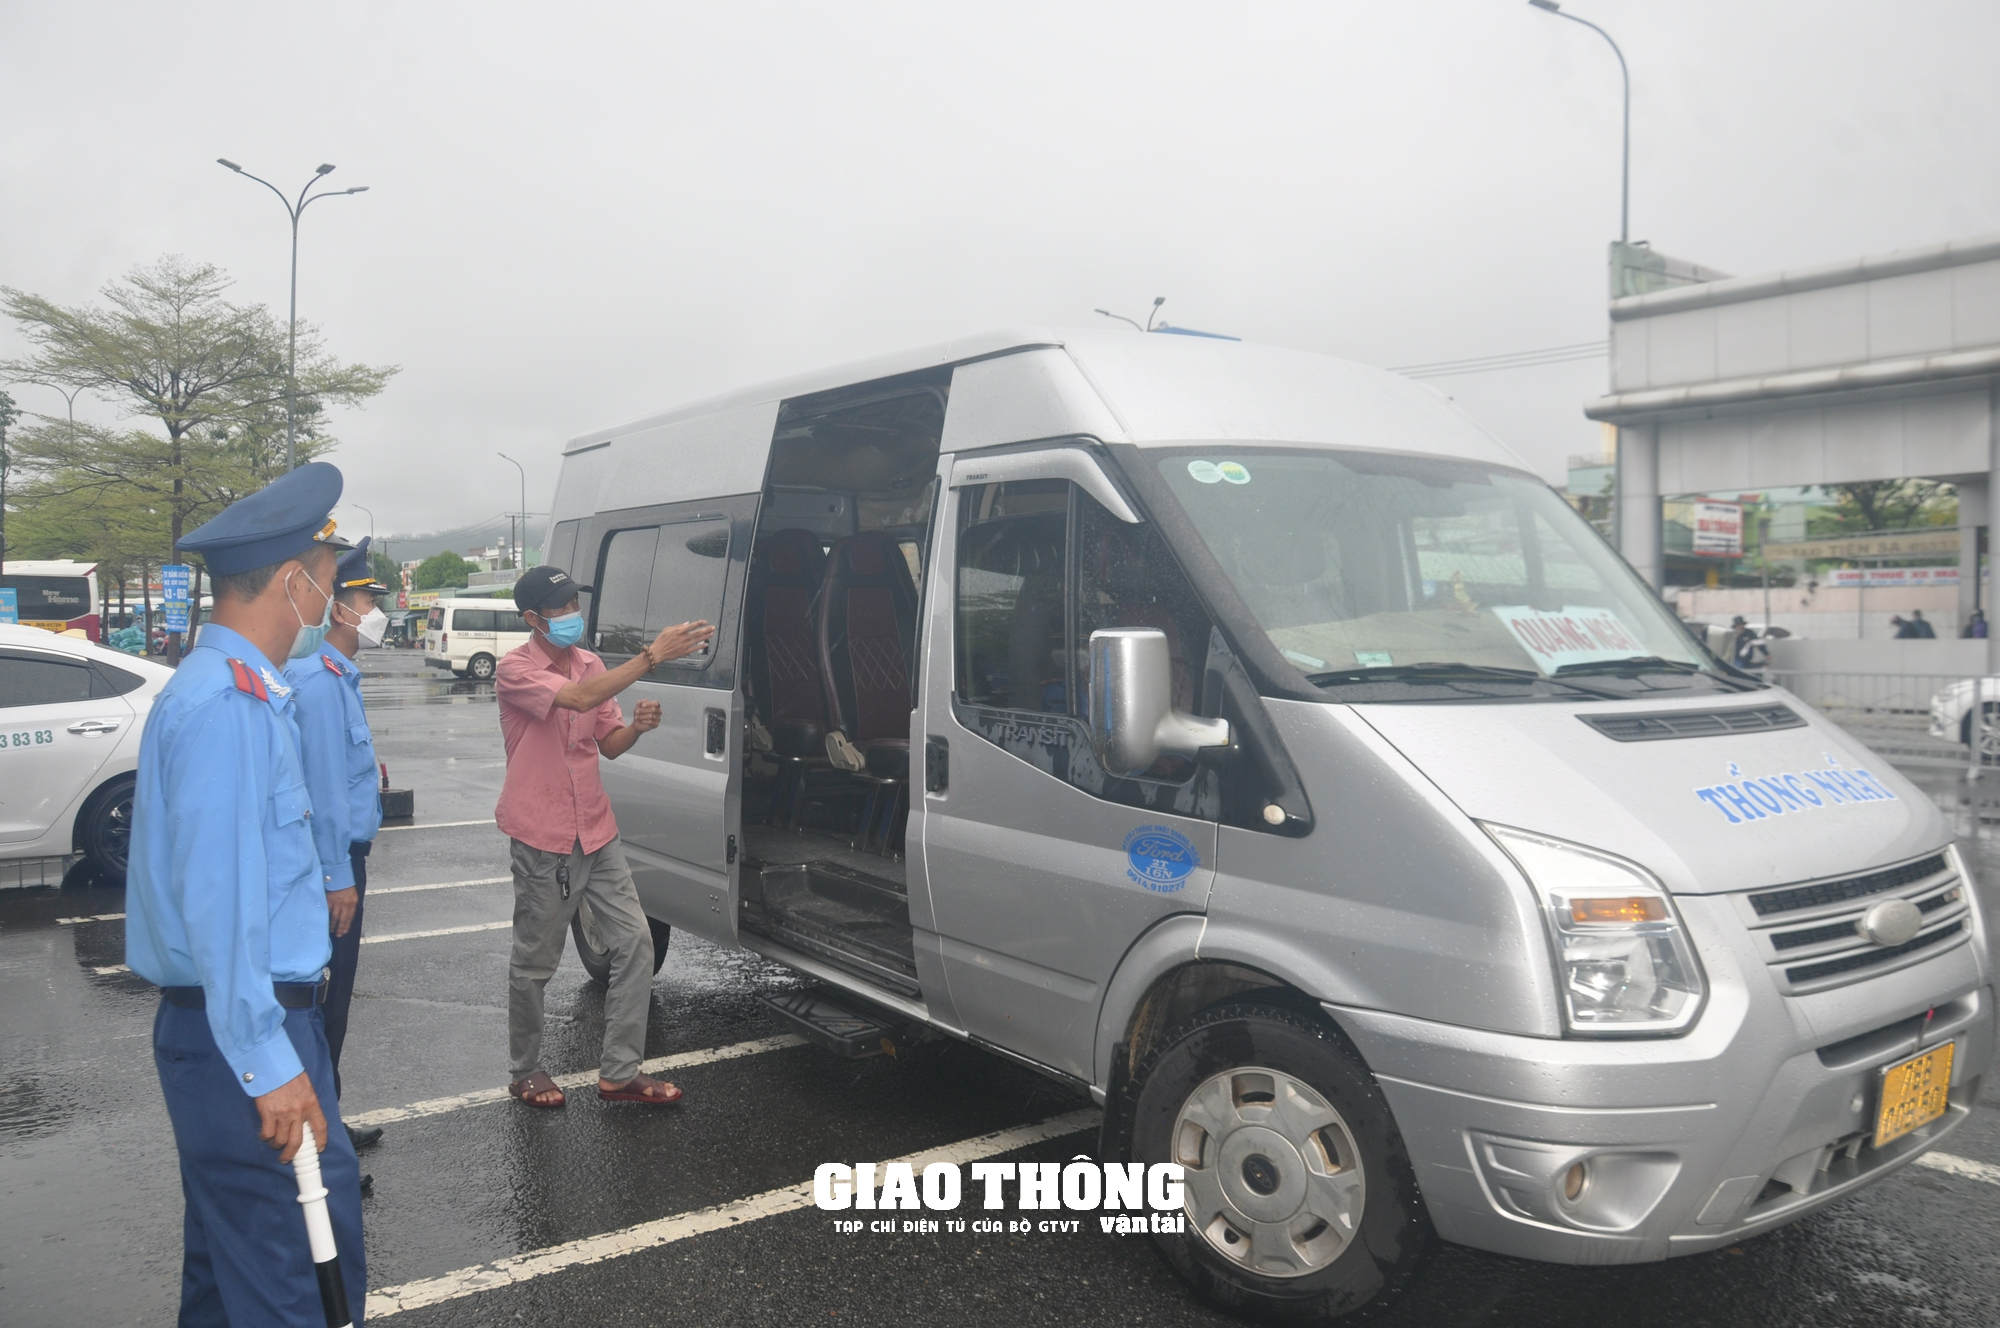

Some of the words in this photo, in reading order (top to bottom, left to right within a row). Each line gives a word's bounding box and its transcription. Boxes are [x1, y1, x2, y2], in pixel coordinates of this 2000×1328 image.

[966, 473, 988, 481] TRANSIT
[1878, 541, 1901, 552] SA
[164, 588, 172, 599] 43
[47, 595, 79, 604] Home
[12, 732, 31, 747] 83
[34, 729, 53, 745] 83
[996, 722, 1071, 746] TRANSIT
[1136, 839, 1185, 863] Ford
[1151, 858, 1169, 869] 2T
[1145, 866, 1173, 879] 16N
